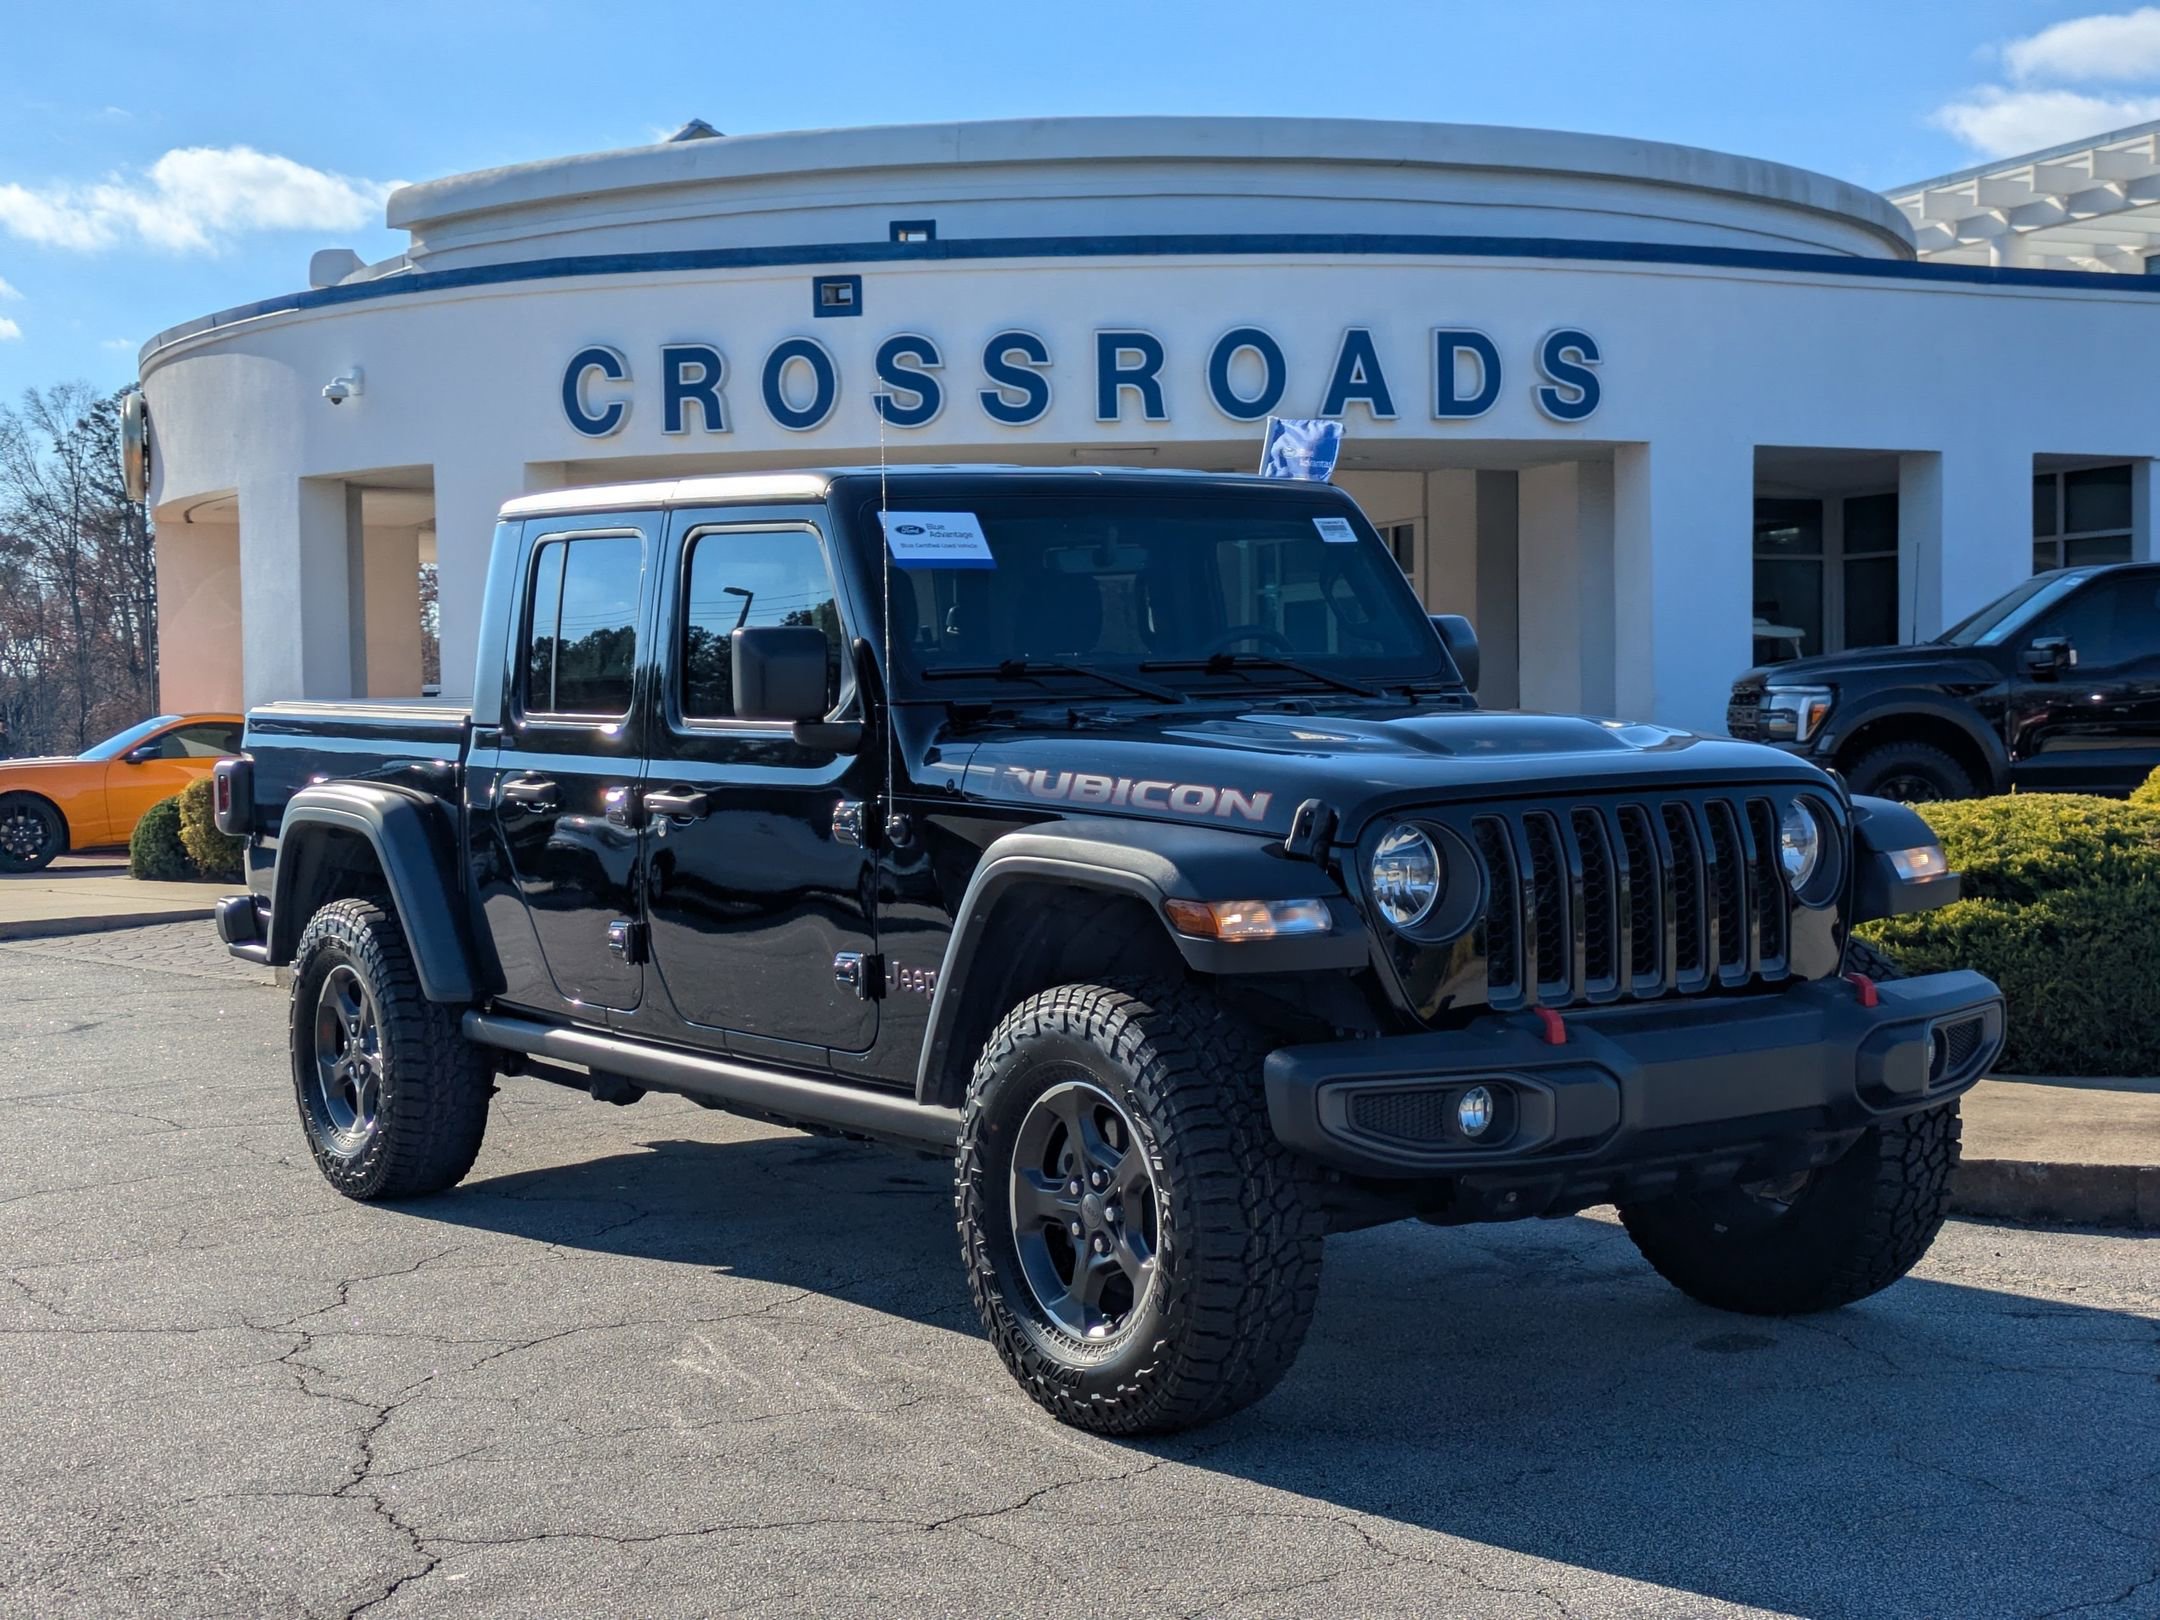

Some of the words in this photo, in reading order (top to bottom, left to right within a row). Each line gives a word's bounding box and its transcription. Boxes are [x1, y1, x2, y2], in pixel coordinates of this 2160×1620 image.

[560, 326, 1604, 438] CROSSROADS
[929, 531, 974, 539] Advantage
[991, 764, 1273, 822] RUBICON
[885, 961, 938, 1000] Jeep
